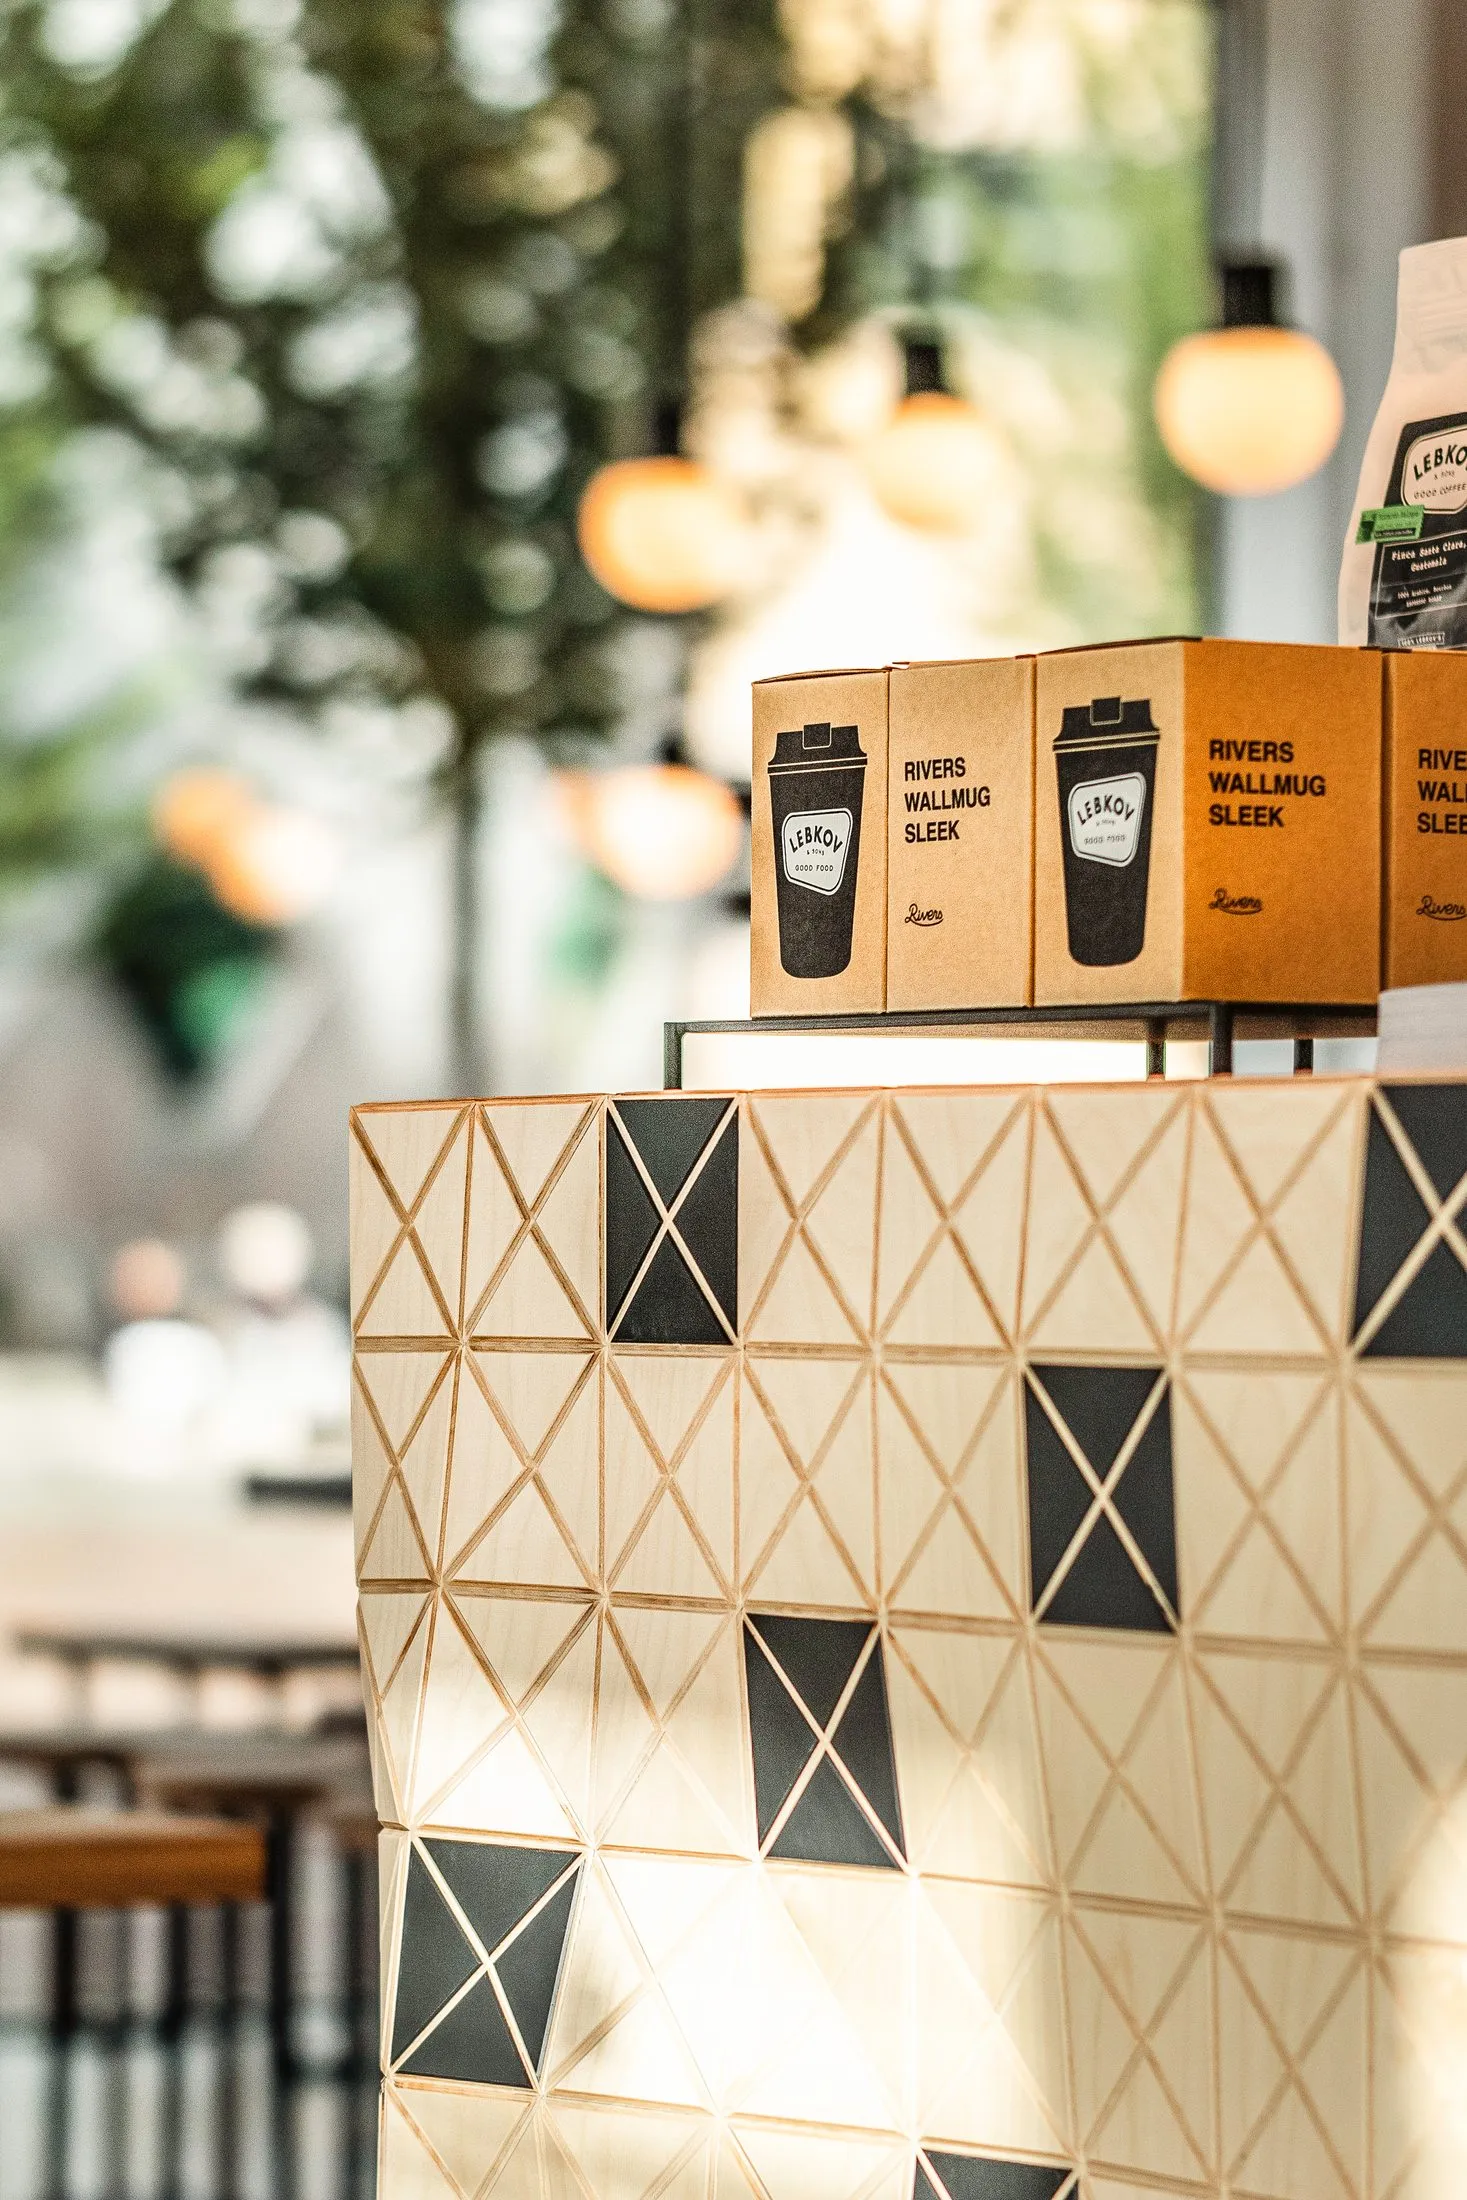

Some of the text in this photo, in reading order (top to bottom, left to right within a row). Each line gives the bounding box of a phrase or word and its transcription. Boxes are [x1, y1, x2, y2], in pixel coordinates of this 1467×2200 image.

[1413, 444, 1467, 481] LEBKO
[1413, 489, 1437, 500] GOOD
[1209, 739, 1294, 763] RIVERS
[904, 756, 966, 782] RIVERS
[1208, 771, 1326, 797] WALLMUG
[1417, 780, 1467, 803] WAL
[904, 786, 991, 813] WALLMUG
[1077, 794, 1135, 825] LEBKOV
[1209, 803, 1285, 828] SLEEK
[789, 825, 843, 853] LEBKOV
[904, 819, 960, 843] SLEEK
[795, 864, 834, 872] GOOD FOOD
[904, 903, 944, 927] Rivers
[1416, 895, 1467, 922] Rivers
